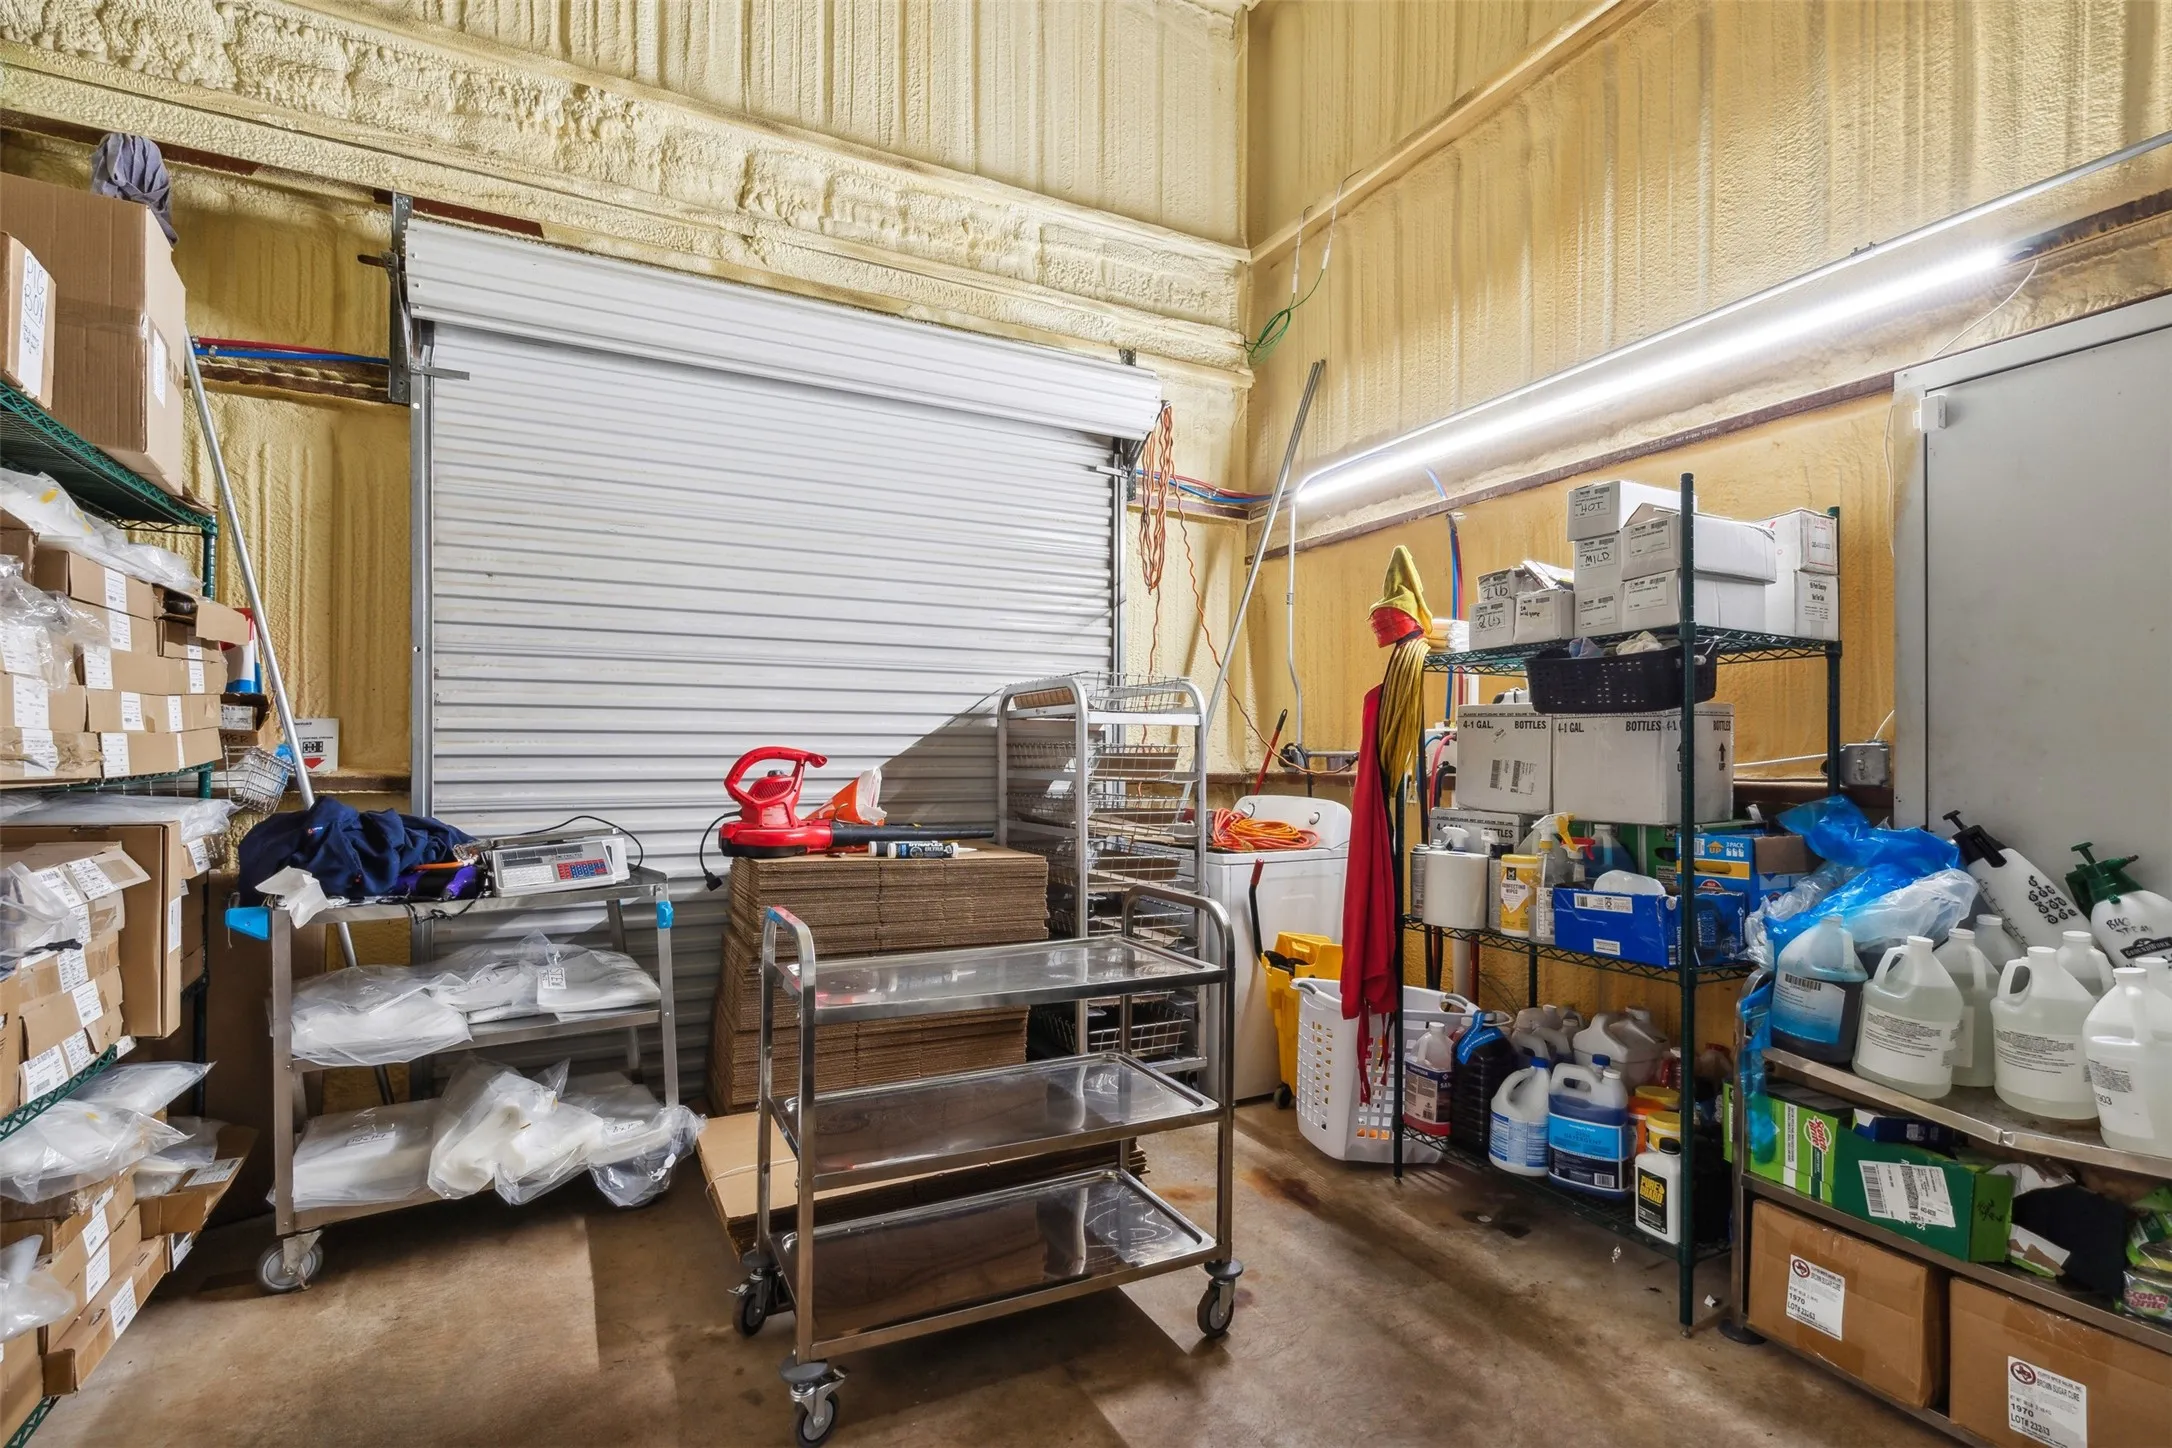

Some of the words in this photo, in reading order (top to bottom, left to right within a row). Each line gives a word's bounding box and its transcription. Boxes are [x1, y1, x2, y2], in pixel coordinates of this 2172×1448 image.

[1581, 501, 1604, 513] HOT
[1585, 551, 1610, 565] MILD
[1463, 720, 1474, 729] 4-1
[1476, 720, 1494, 729] GAL.
[1514, 720, 1547, 729] BOTTLES
[1569, 722, 1584, 733] GAL.
[1625, 720, 1661, 731] BOTTLES
[1713, 720, 1731, 731] BOTTLES
[1718, 762, 1725, 771] UP
[1789, 1293, 1805, 1304] 1970
[1788, 1302, 1800, 1313] LOT#
[2053, 1384, 2068, 1397] SUGAR
[2068, 1390, 2080, 1402] CURE
[2011, 1403, 2034, 1418] 1970
[2011, 1413, 2029, 1426] LOT#
